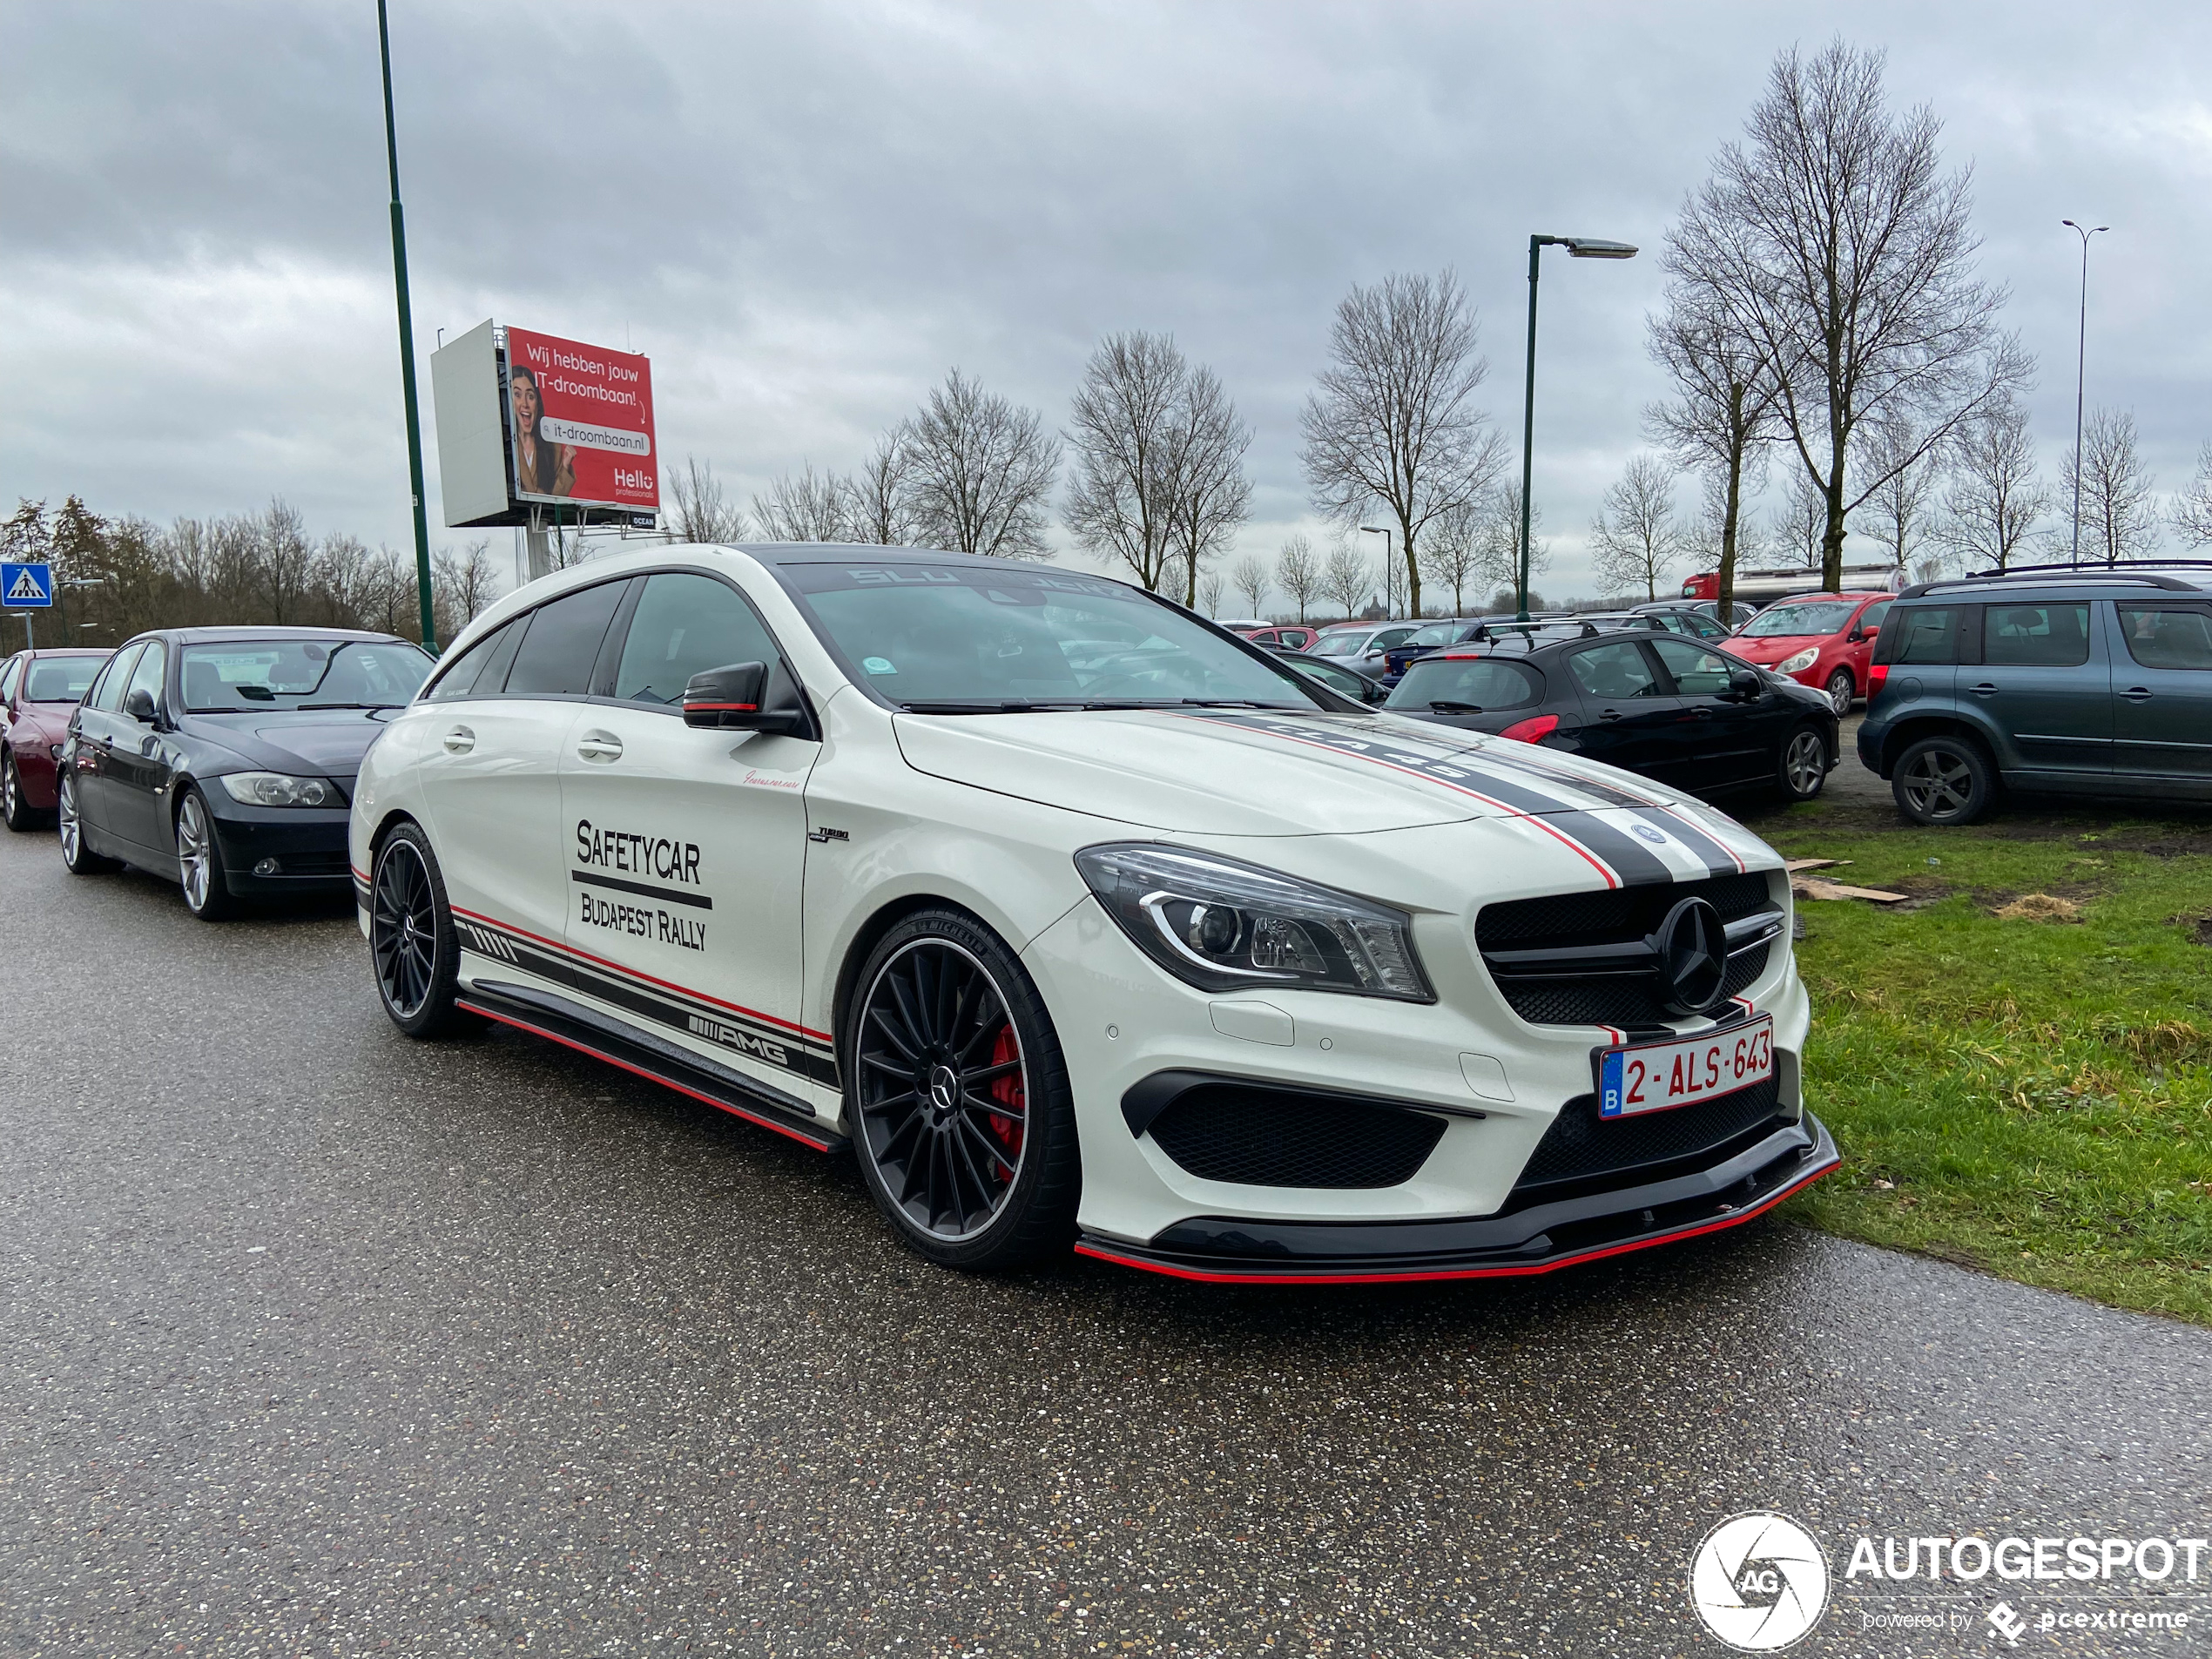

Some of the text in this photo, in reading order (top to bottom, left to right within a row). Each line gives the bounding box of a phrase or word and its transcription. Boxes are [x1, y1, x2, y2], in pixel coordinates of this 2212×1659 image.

[526, 343, 639, 382] Wij hebben jouw
[534, 371, 637, 406] IT-droombaan!
[554, 423, 644, 450] it-droombaan.nl
[614, 468, 653, 489] Hello
[616, 488, 655, 499] professionals
[633, 516, 654, 526] OCEAN
[1267, 725, 1471, 779] CLA 45
[577, 819, 701, 885] SAFETYCAR
[581, 892, 706, 952] BUDAPEST RALLY
[929, 921, 985, 953] MICHELIN
[718, 1026, 788, 1065] AMG
[1605, 1028, 1770, 1110] B 2-ALS-643
